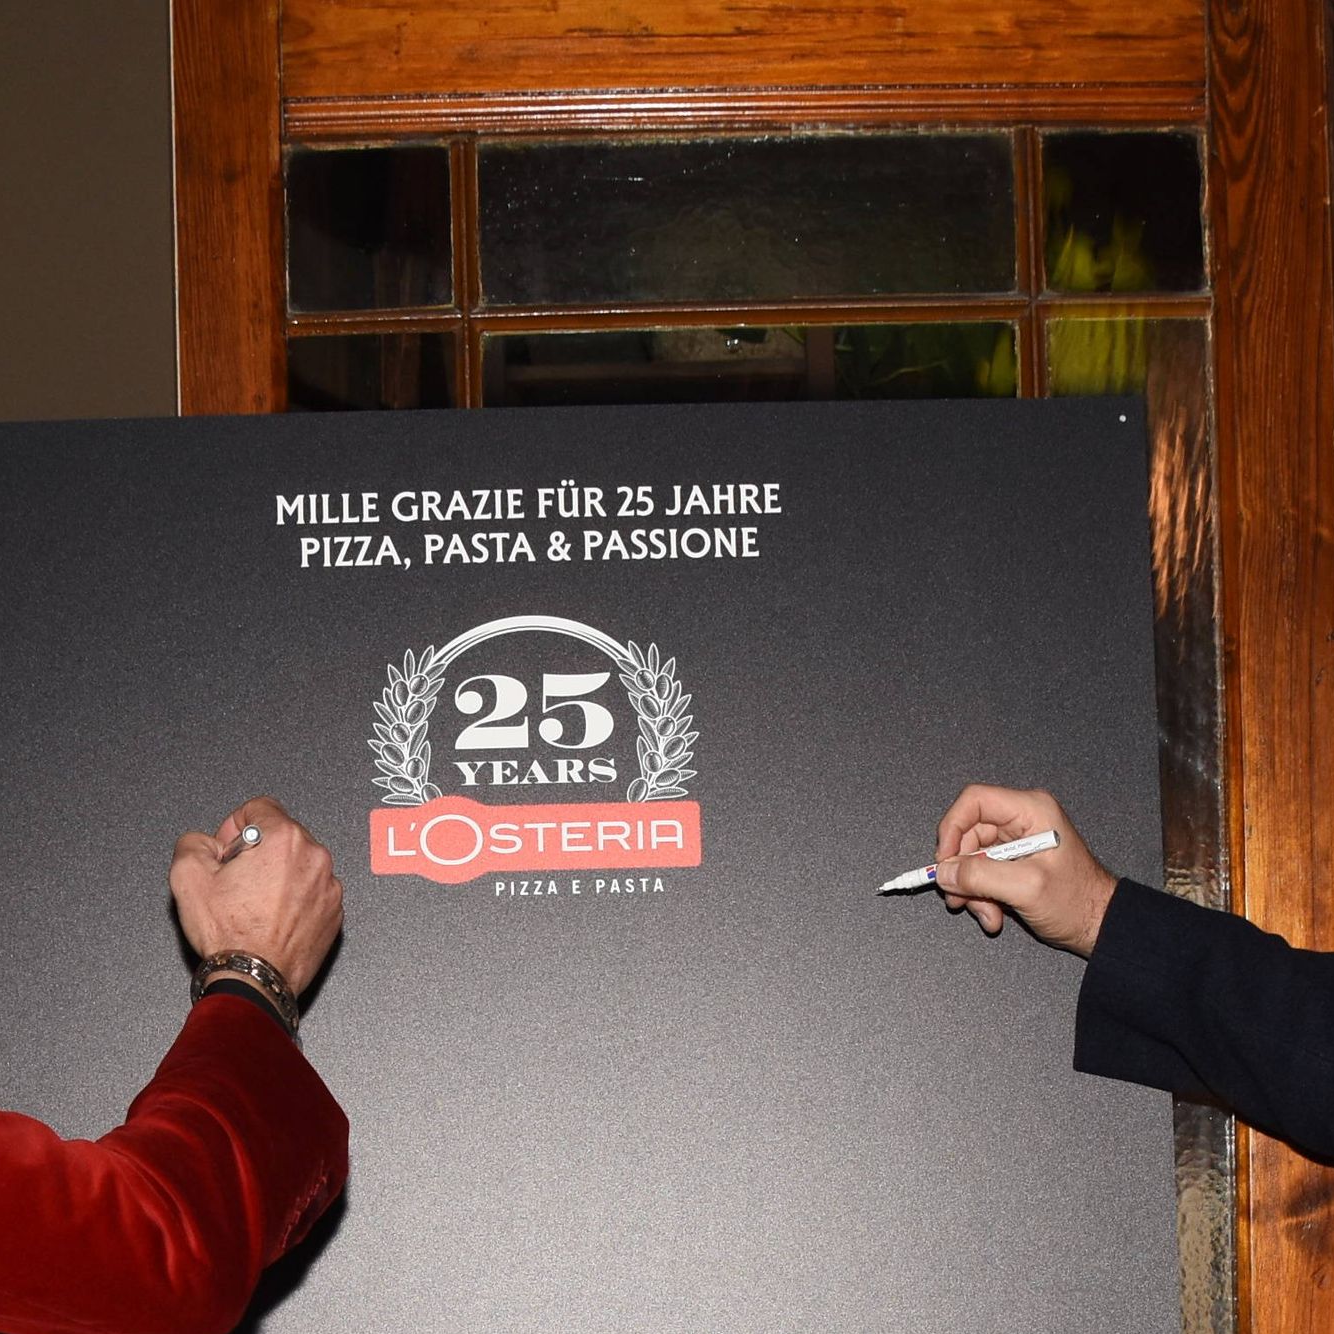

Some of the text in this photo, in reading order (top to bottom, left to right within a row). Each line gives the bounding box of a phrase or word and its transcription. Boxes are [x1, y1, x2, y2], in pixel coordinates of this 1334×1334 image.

[275, 478, 783, 526] MILLE GRAZIE FÜR 25 JAHRE
[299, 526, 760, 571] PIZZA, PASTA & PASSIONE
[454, 671, 615, 750] 25
[452, 756, 618, 786] YEARS
[387, 813, 684, 866] L'OSTERIA
[495, 877, 665, 896] PIZZA E PASTA
